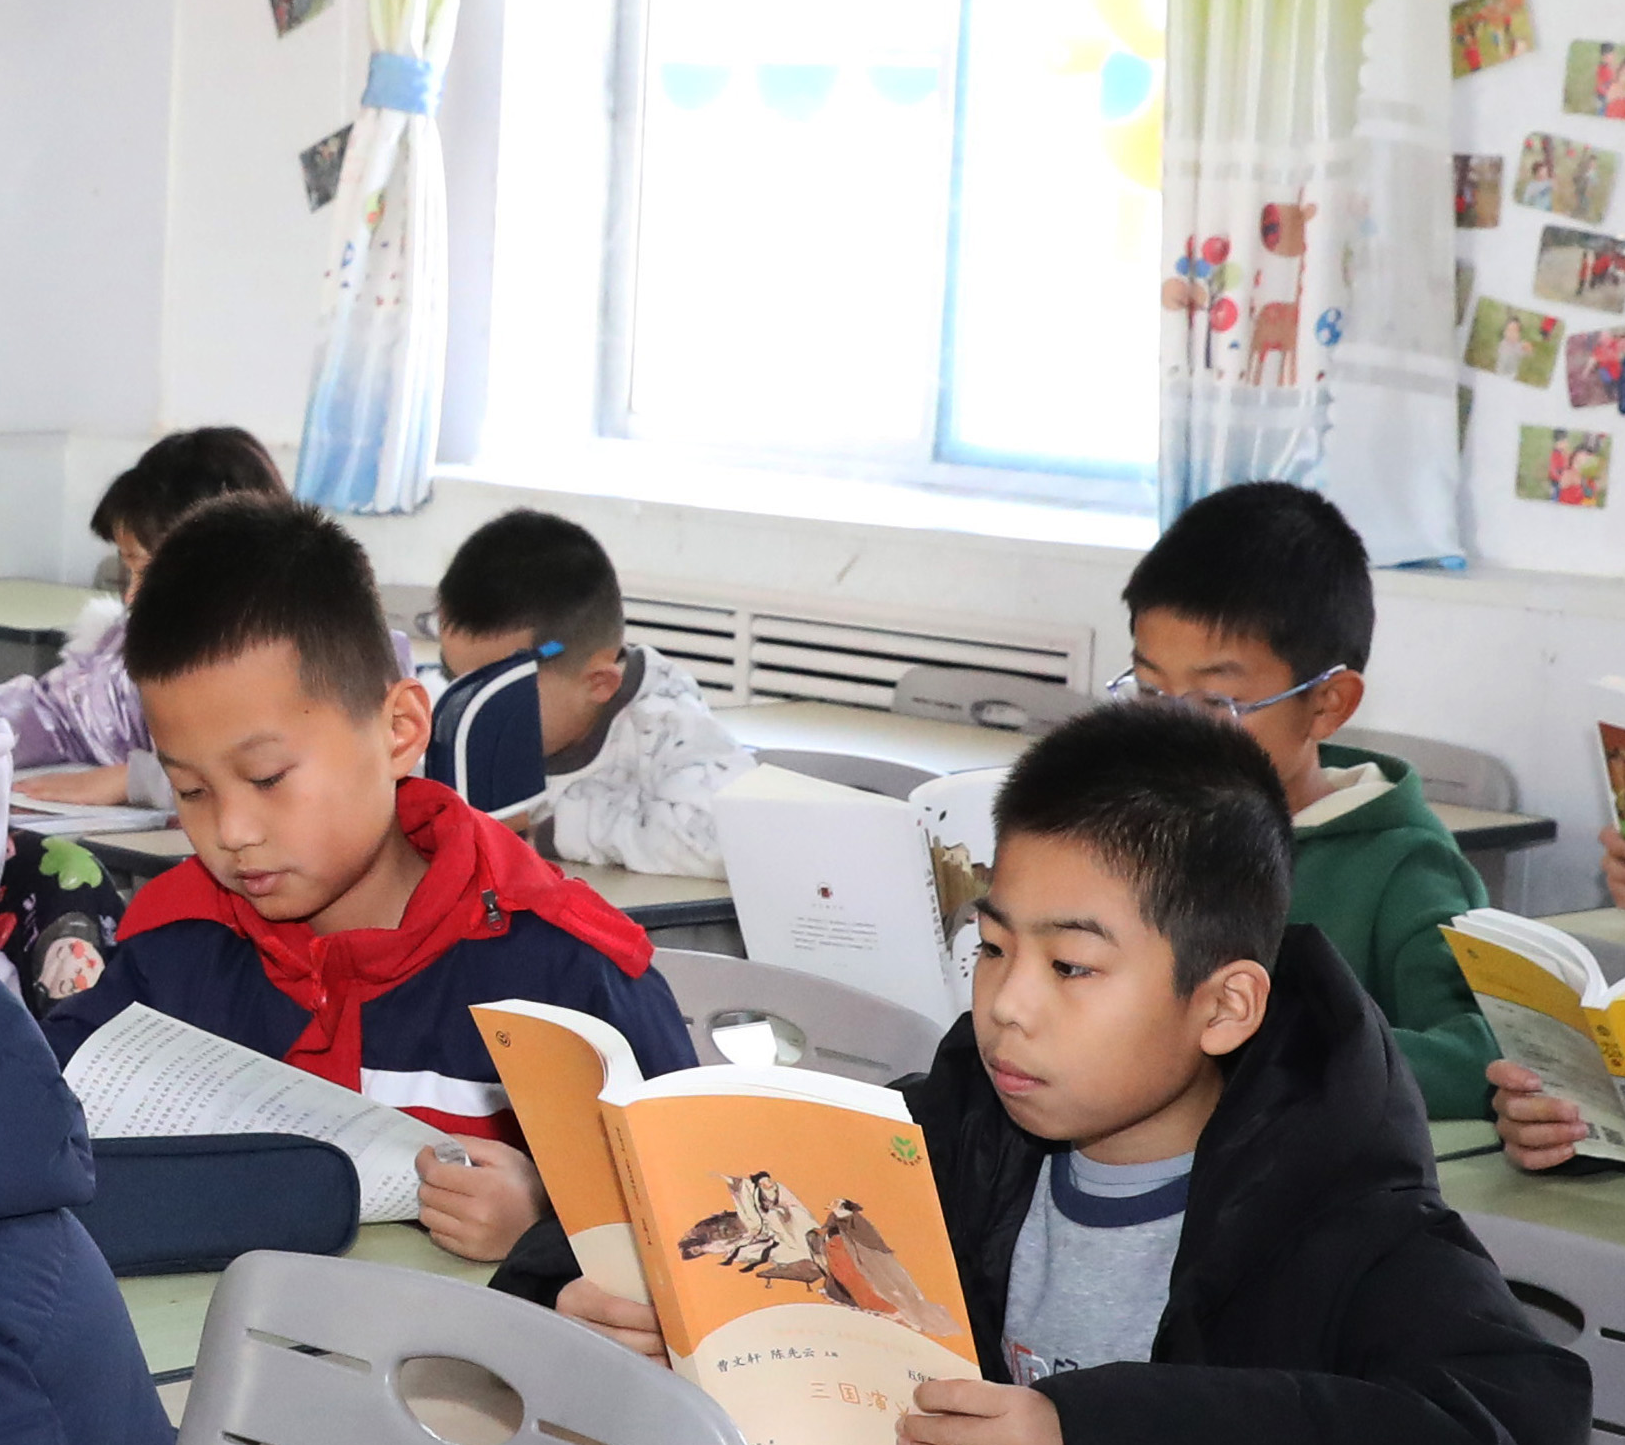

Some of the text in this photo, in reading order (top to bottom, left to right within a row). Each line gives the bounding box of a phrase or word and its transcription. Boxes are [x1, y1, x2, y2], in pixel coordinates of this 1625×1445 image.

[716, 1352, 762, 1373] 曹文轩
[770, 1347, 816, 1359] 陈先云
